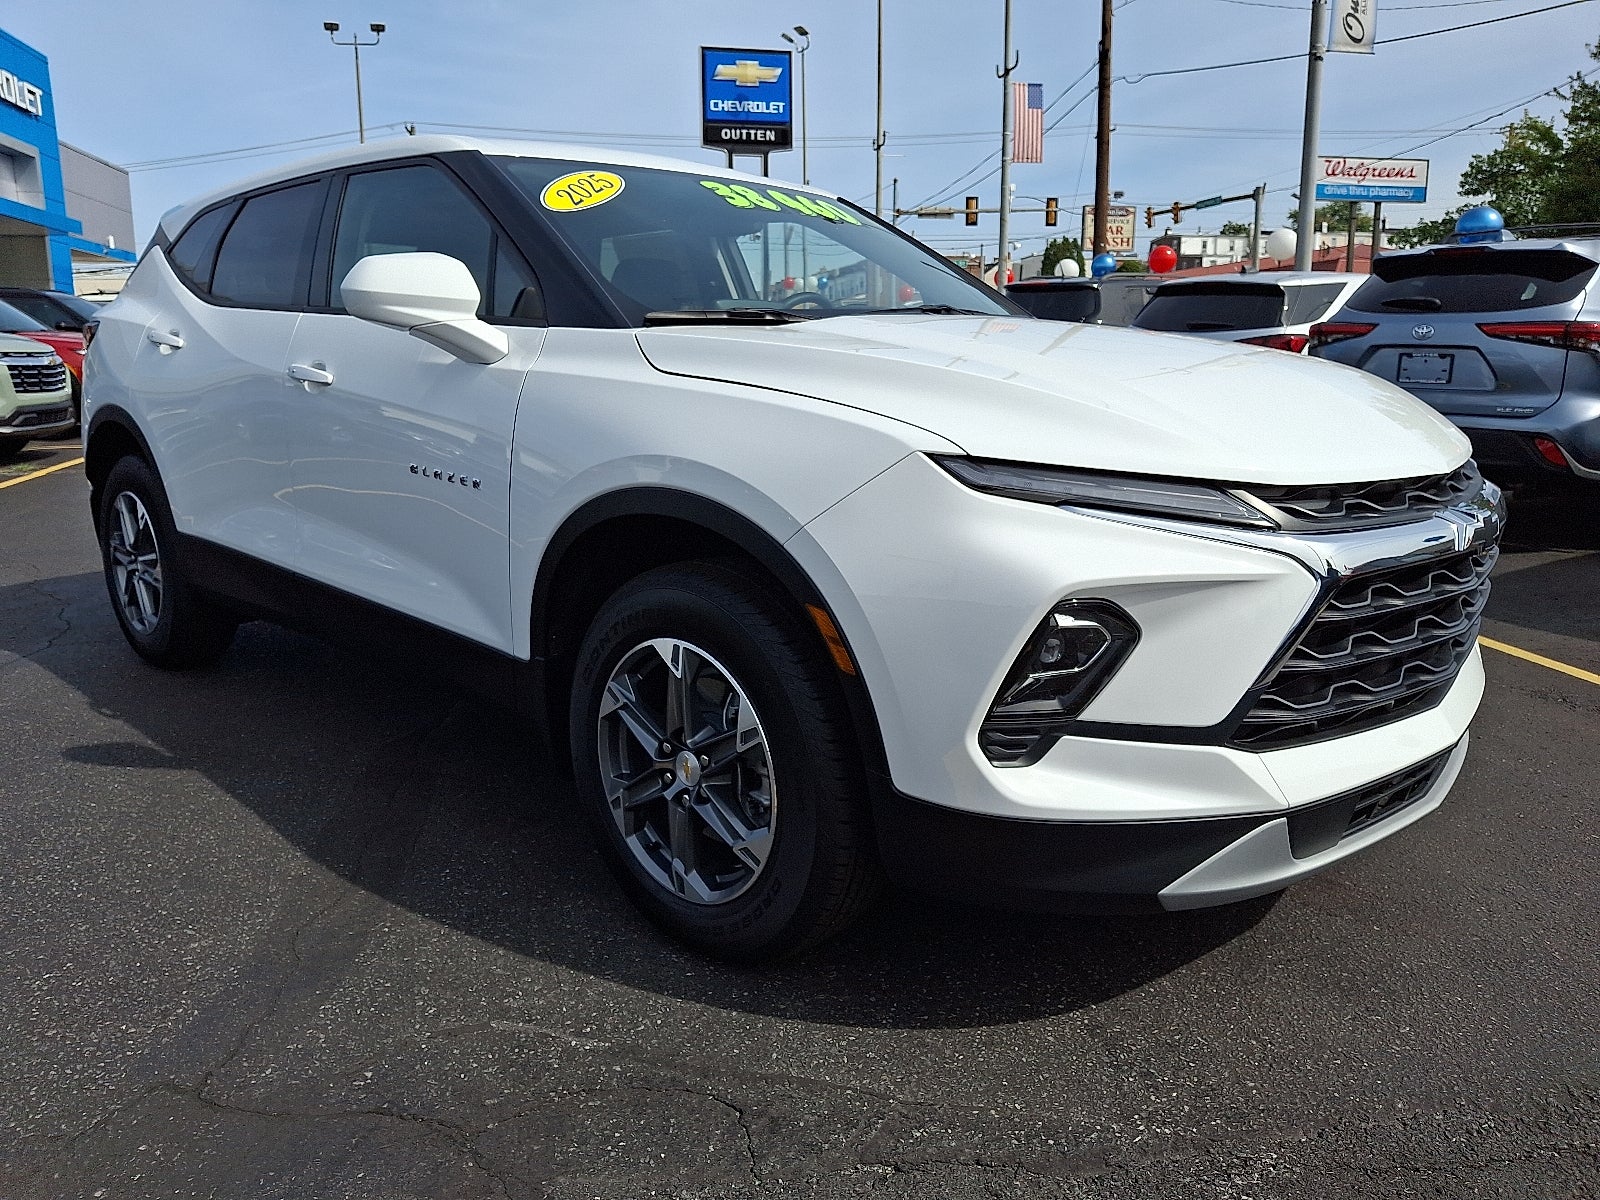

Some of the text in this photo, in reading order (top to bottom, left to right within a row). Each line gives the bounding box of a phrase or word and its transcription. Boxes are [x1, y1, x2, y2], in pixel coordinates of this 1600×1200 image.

[709, 99, 786, 114] CHEVROLET
[721, 128, 776, 141] OUTTEN
[1324, 158, 1417, 184] Walgreens
[556, 174, 614, 206] 2025
[1324, 185, 1415, 199] drive thru pharmacy
[1106, 225, 1124, 236] AR
[409, 463, 483, 491] BLAZER
